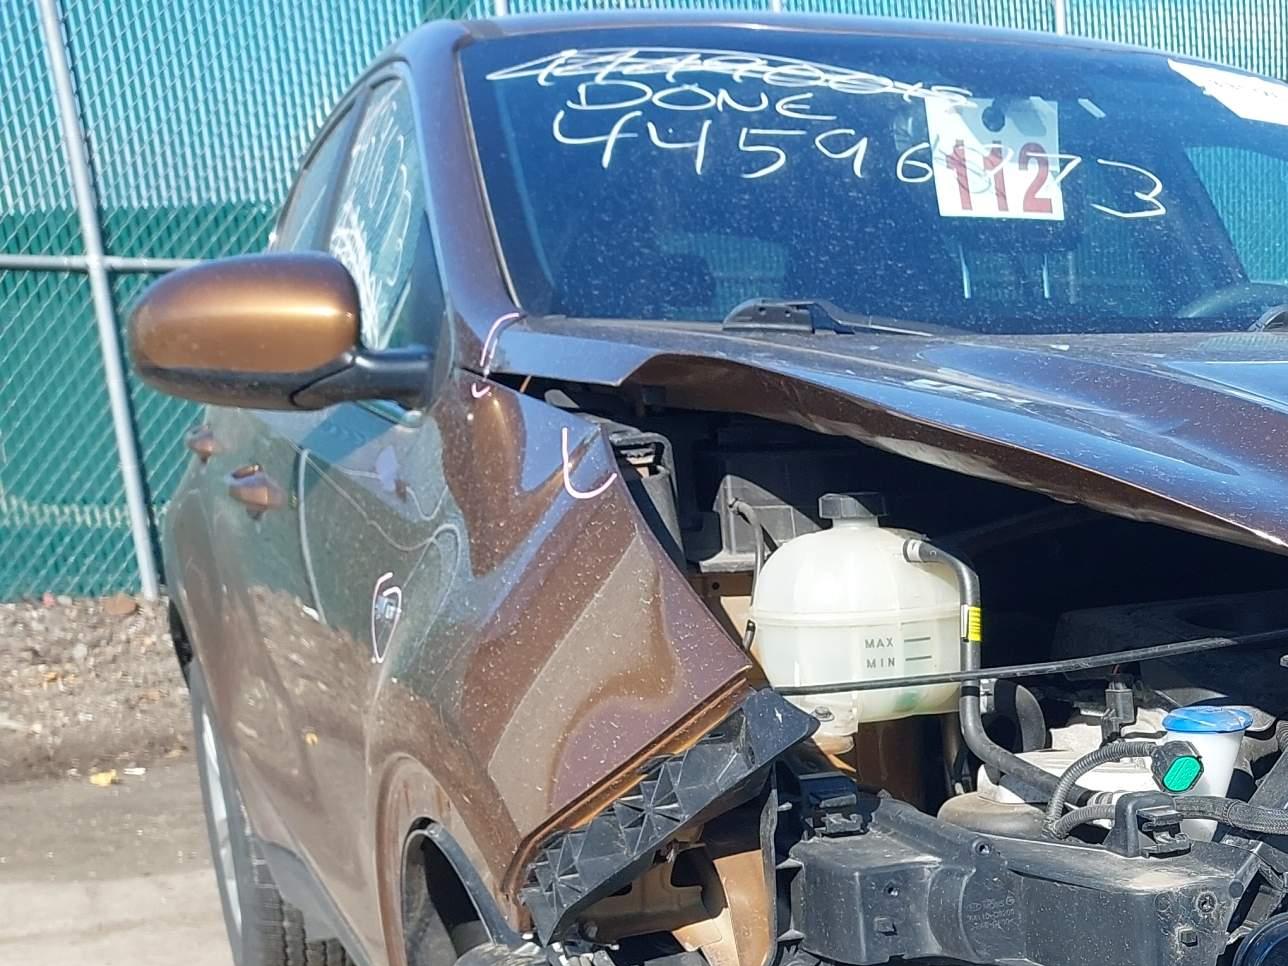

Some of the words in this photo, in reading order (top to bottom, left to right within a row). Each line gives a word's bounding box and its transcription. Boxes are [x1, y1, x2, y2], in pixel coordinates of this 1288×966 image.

[565, 80, 838, 121] DONE
[945, 139, 1054, 214] 112
[864, 637, 895, 649] MAX
[866, 657, 896, 669] MIN
